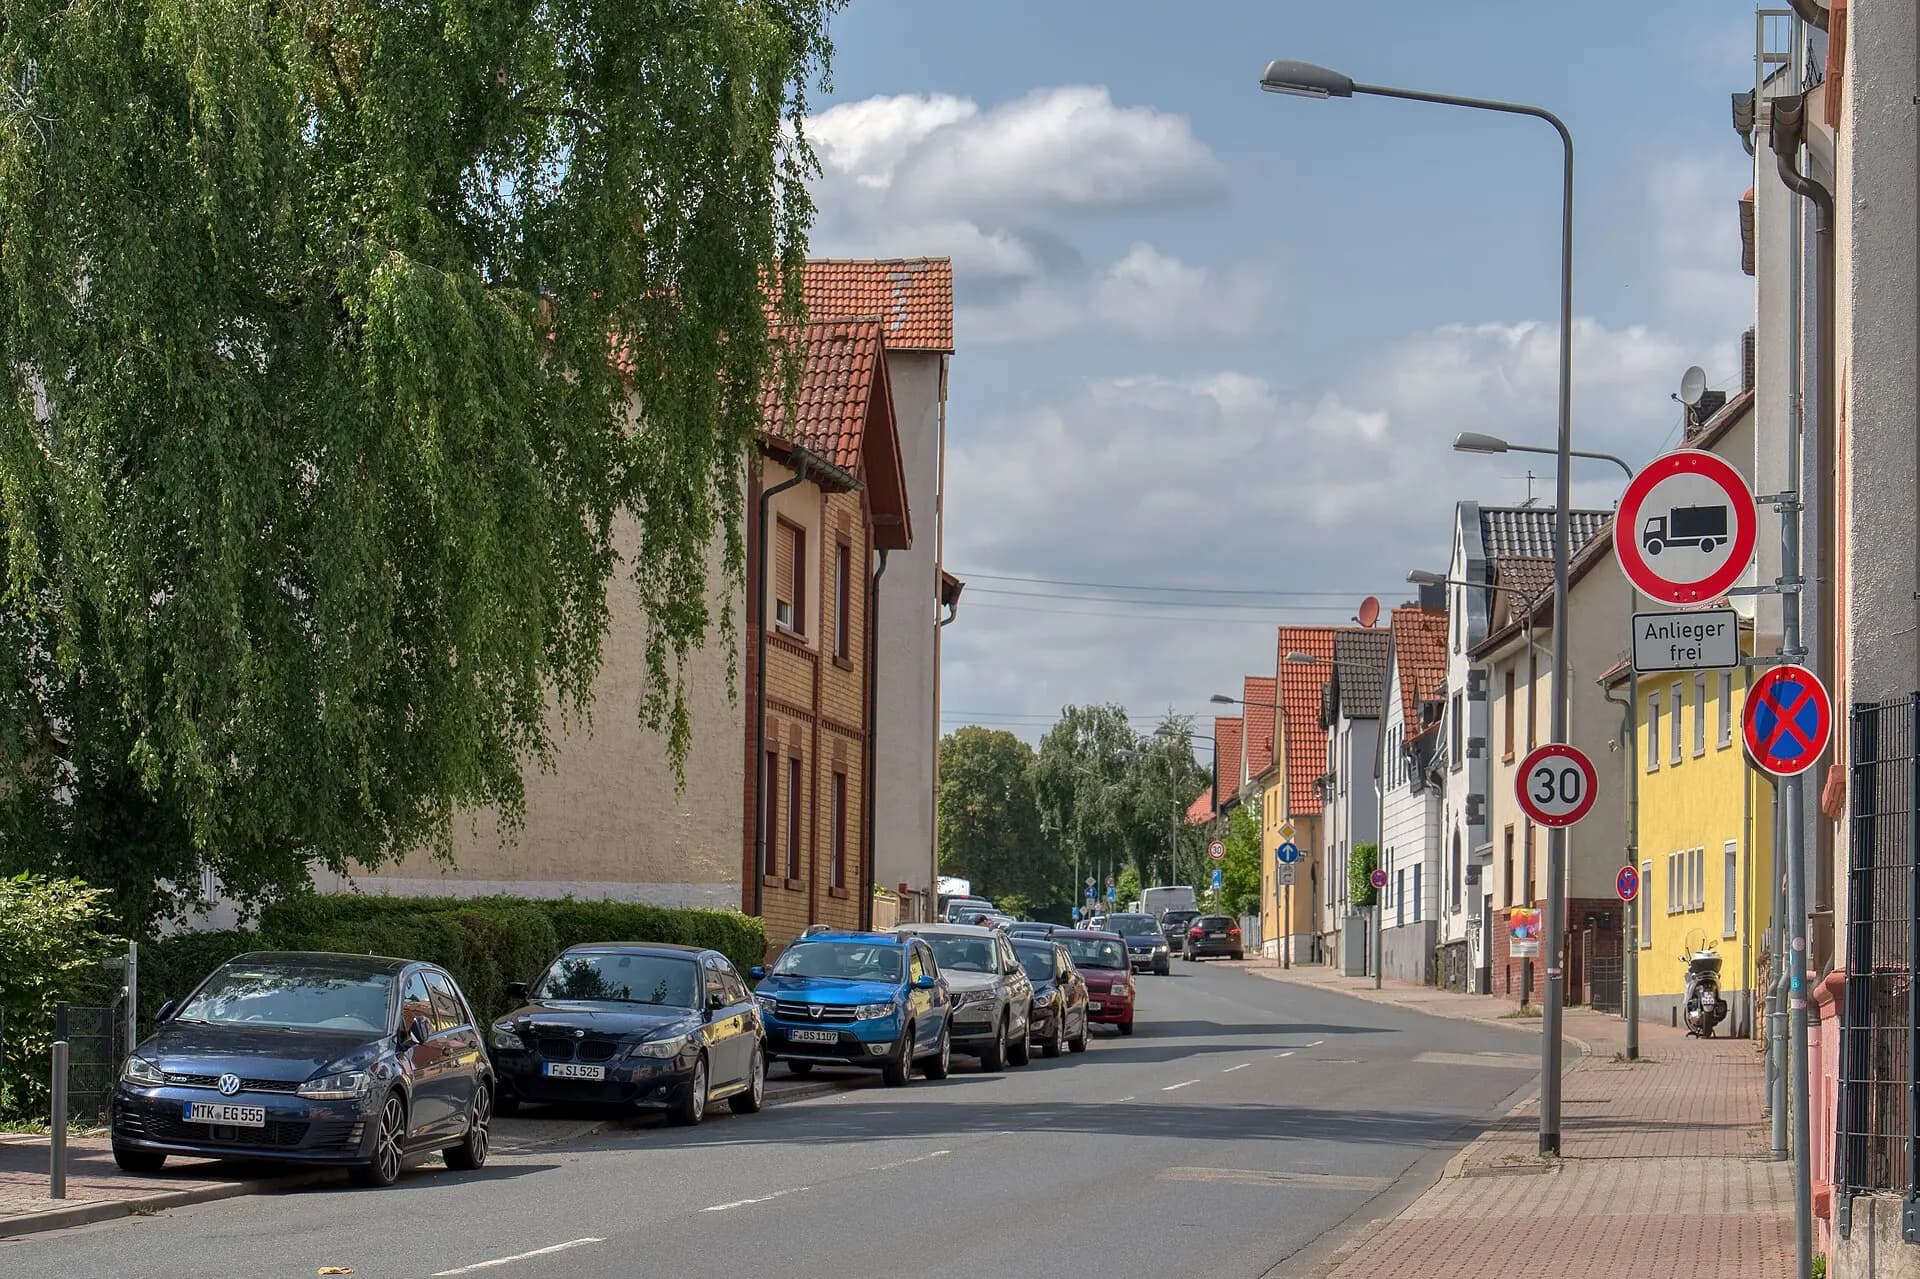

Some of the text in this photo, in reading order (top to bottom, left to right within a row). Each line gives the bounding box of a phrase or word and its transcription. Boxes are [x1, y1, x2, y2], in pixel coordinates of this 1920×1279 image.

[1645, 621, 1725, 642] Anlieger
[1670, 643, 1702, 661] frei
[1534, 767, 1580, 804] 30
[1213, 845, 1221, 855] 30
[793, 1031, 799, 1040] F
[803, 1031, 815, 1040] BS
[552, 1064, 600, 1078] F SI 525
[192, 1104, 263, 1122] MTK EG 555
